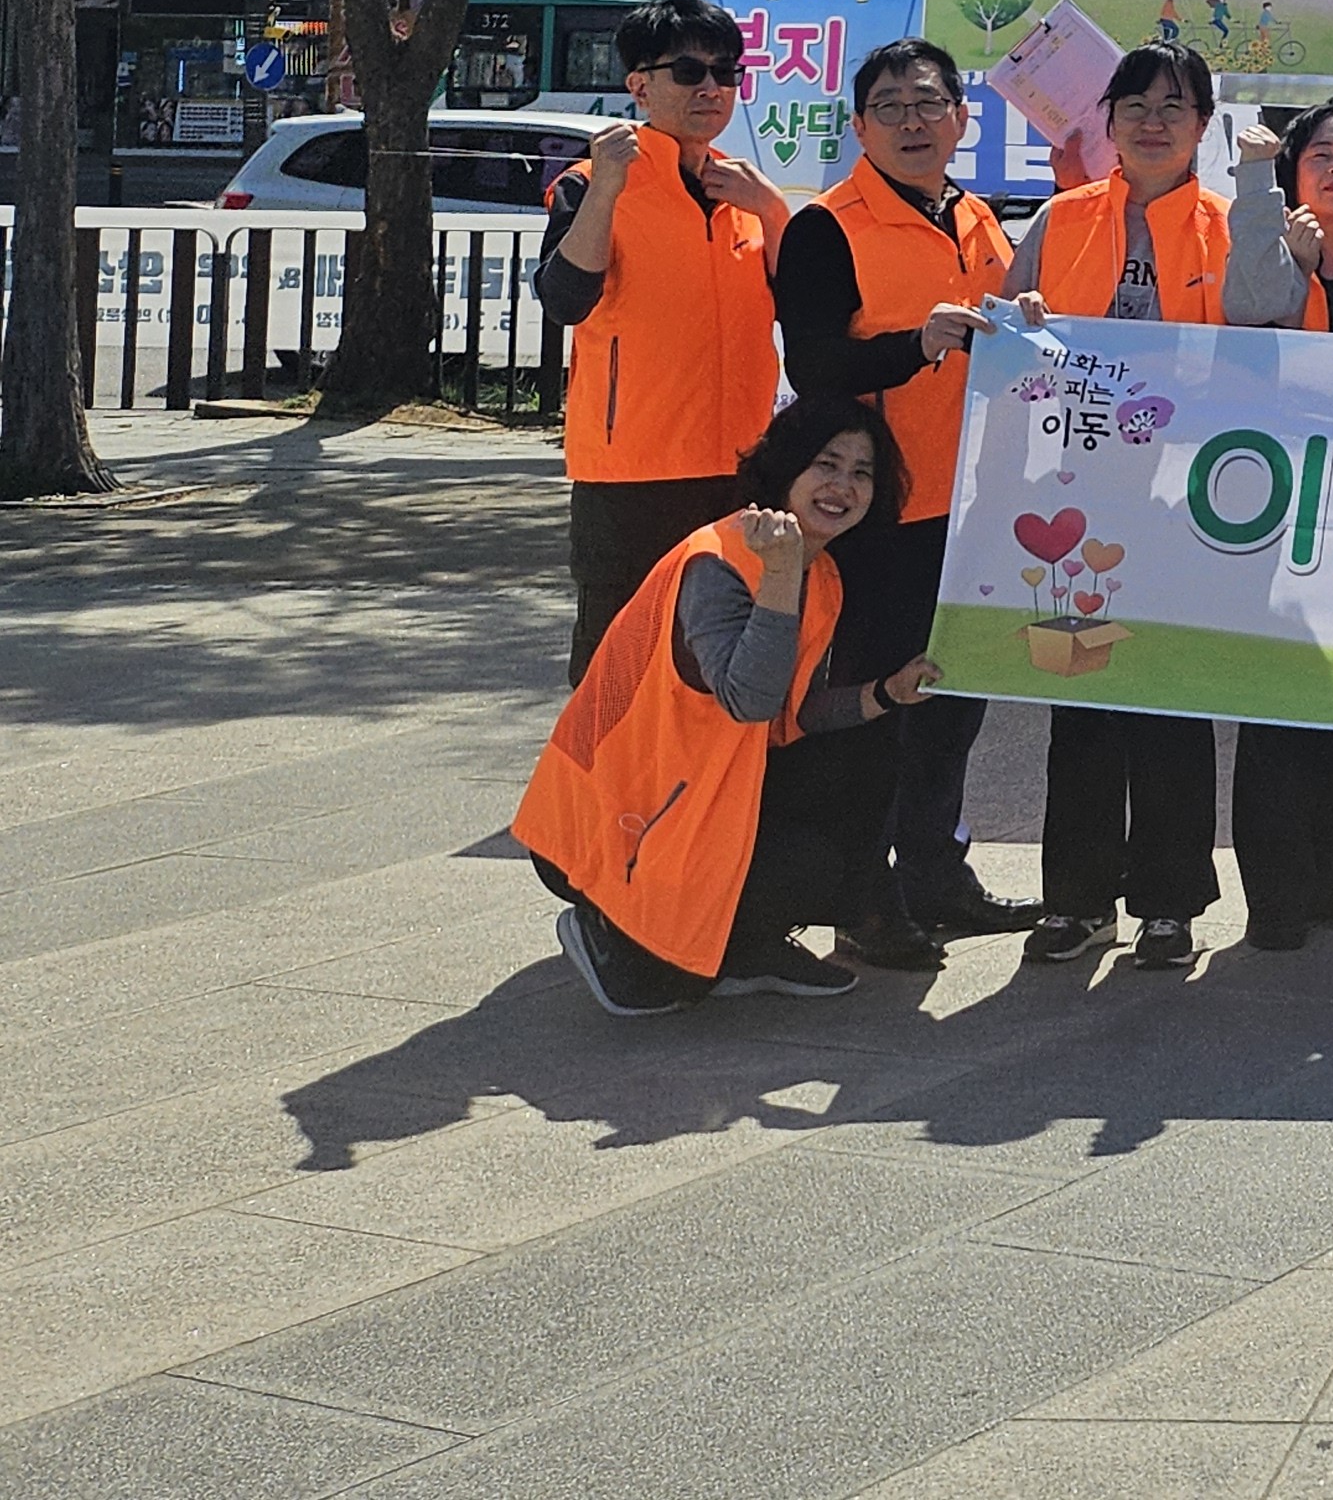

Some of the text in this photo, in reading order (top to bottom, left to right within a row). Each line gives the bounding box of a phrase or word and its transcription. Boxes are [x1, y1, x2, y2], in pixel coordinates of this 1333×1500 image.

[758, 101, 851, 165] 상담
[1042, 347, 1130, 383] 매화가
[1064, 378, 1116, 406] 피는
[1042, 407, 1112, 452] 이동
